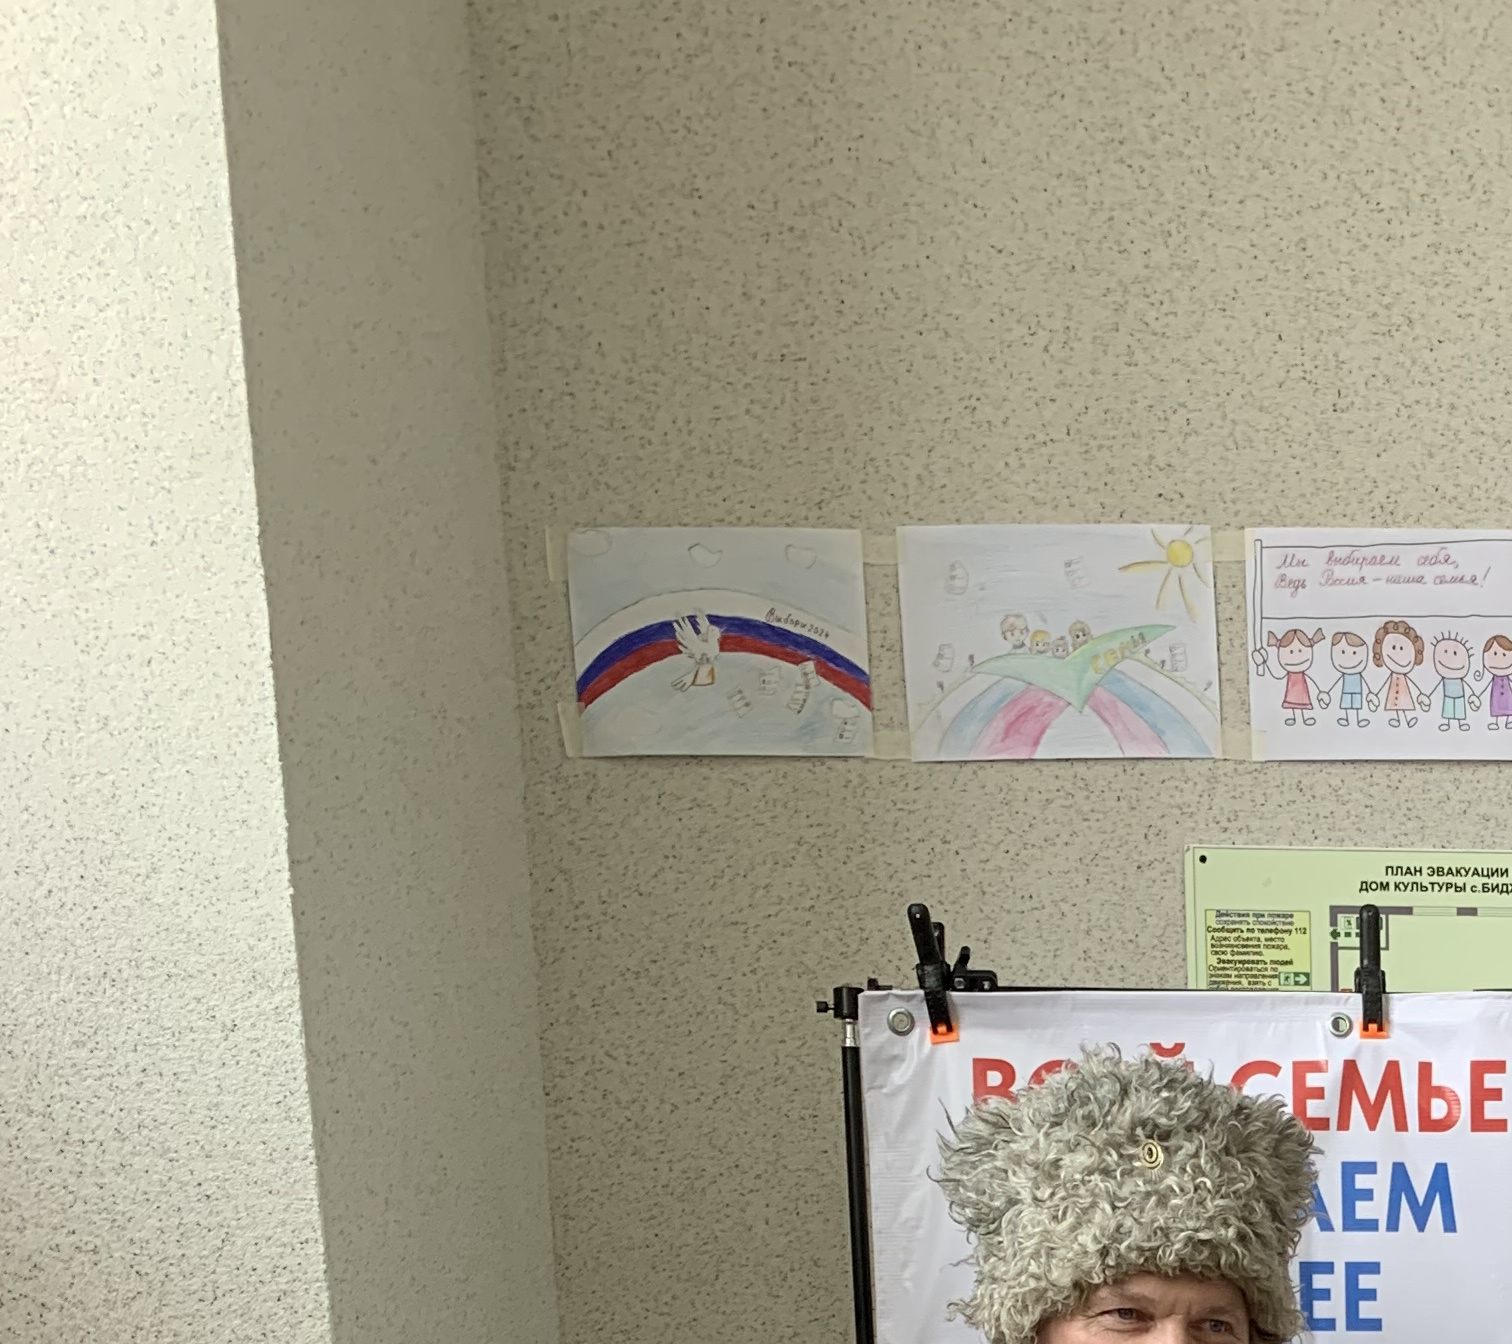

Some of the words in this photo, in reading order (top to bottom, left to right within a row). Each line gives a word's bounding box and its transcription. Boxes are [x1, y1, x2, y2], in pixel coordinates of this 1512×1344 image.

[1276, 554, 1309, 569] Мы
[1325, 549, 1400, 572] выбираем
[1274, 573, 1307, 597] Ведь
[1319, 569, 1367, 587] Россия
[1385, 573, 1427, 585] наша
[1385, 866, 1423, 878] ПЛАН
[1426, 866, 1509, 880] ЭВАКУАЦИИ
[1359, 881, 1391, 895] ДОМ
[1393, 881, 1466, 894] КУЛЬТУРЫ
